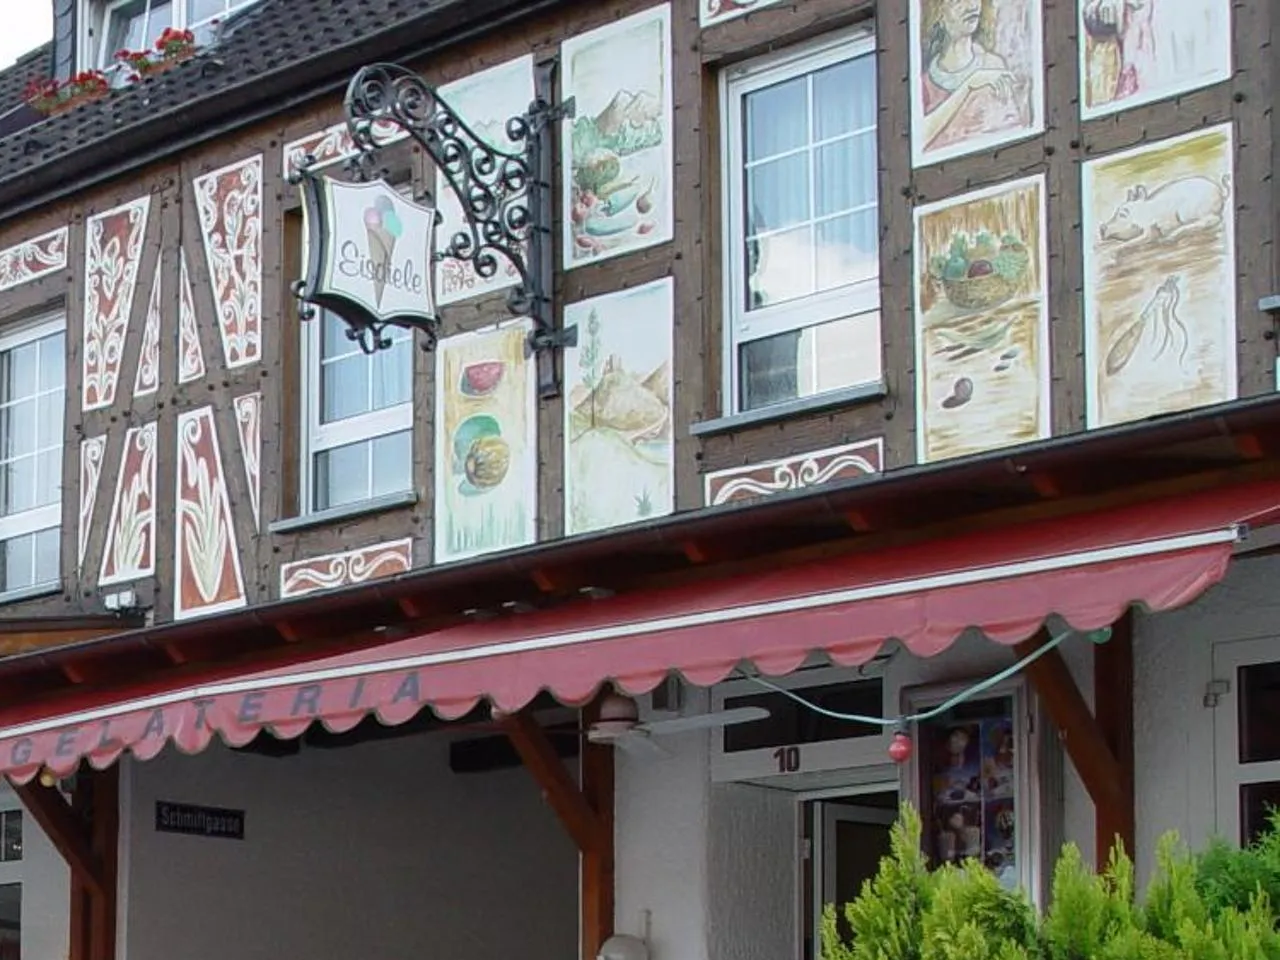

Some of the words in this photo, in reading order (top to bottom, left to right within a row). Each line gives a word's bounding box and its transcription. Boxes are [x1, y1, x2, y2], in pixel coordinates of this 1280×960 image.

[338, 239, 422, 294] Eisdiele
[10, 671, 420, 766] GELATERIA
[773, 746, 800, 772] 10
